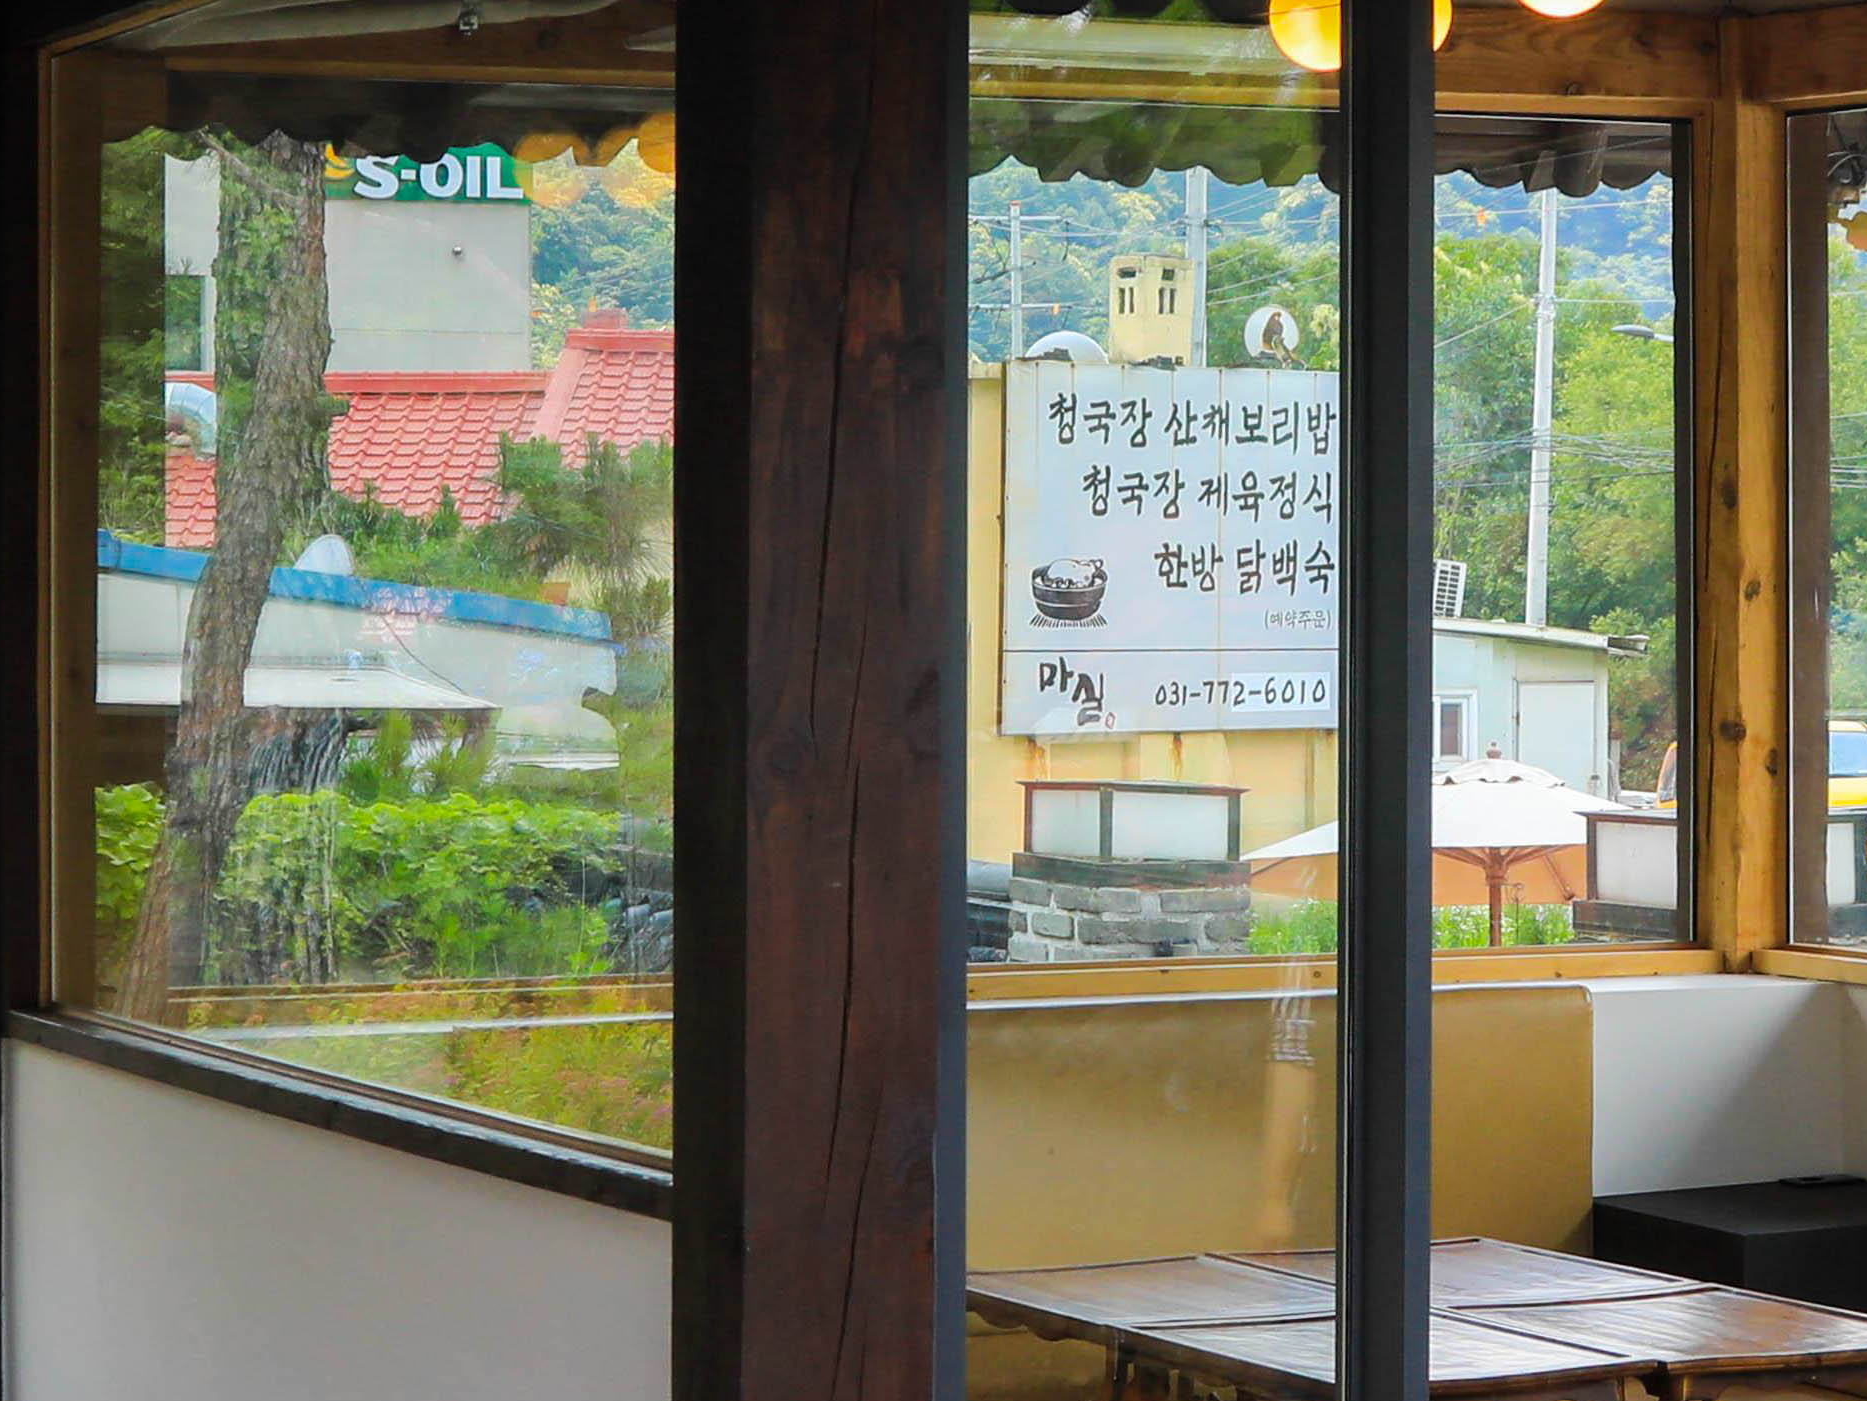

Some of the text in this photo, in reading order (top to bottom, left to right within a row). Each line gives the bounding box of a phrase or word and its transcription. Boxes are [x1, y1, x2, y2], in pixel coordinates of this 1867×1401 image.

[352, 153, 525, 200] S-OIL
[1048, 392, 1337, 455] 청국장 산채보리밥
[1082, 464, 1333, 524] 청국장 제육정식
[1153, 538, 1336, 597] 한방 닭백숙
[1264, 608, 1332, 631] (예약주문)
[1038, 655, 1106, 727] 마실
[1154, 676, 1327, 707] 031-772-6010
